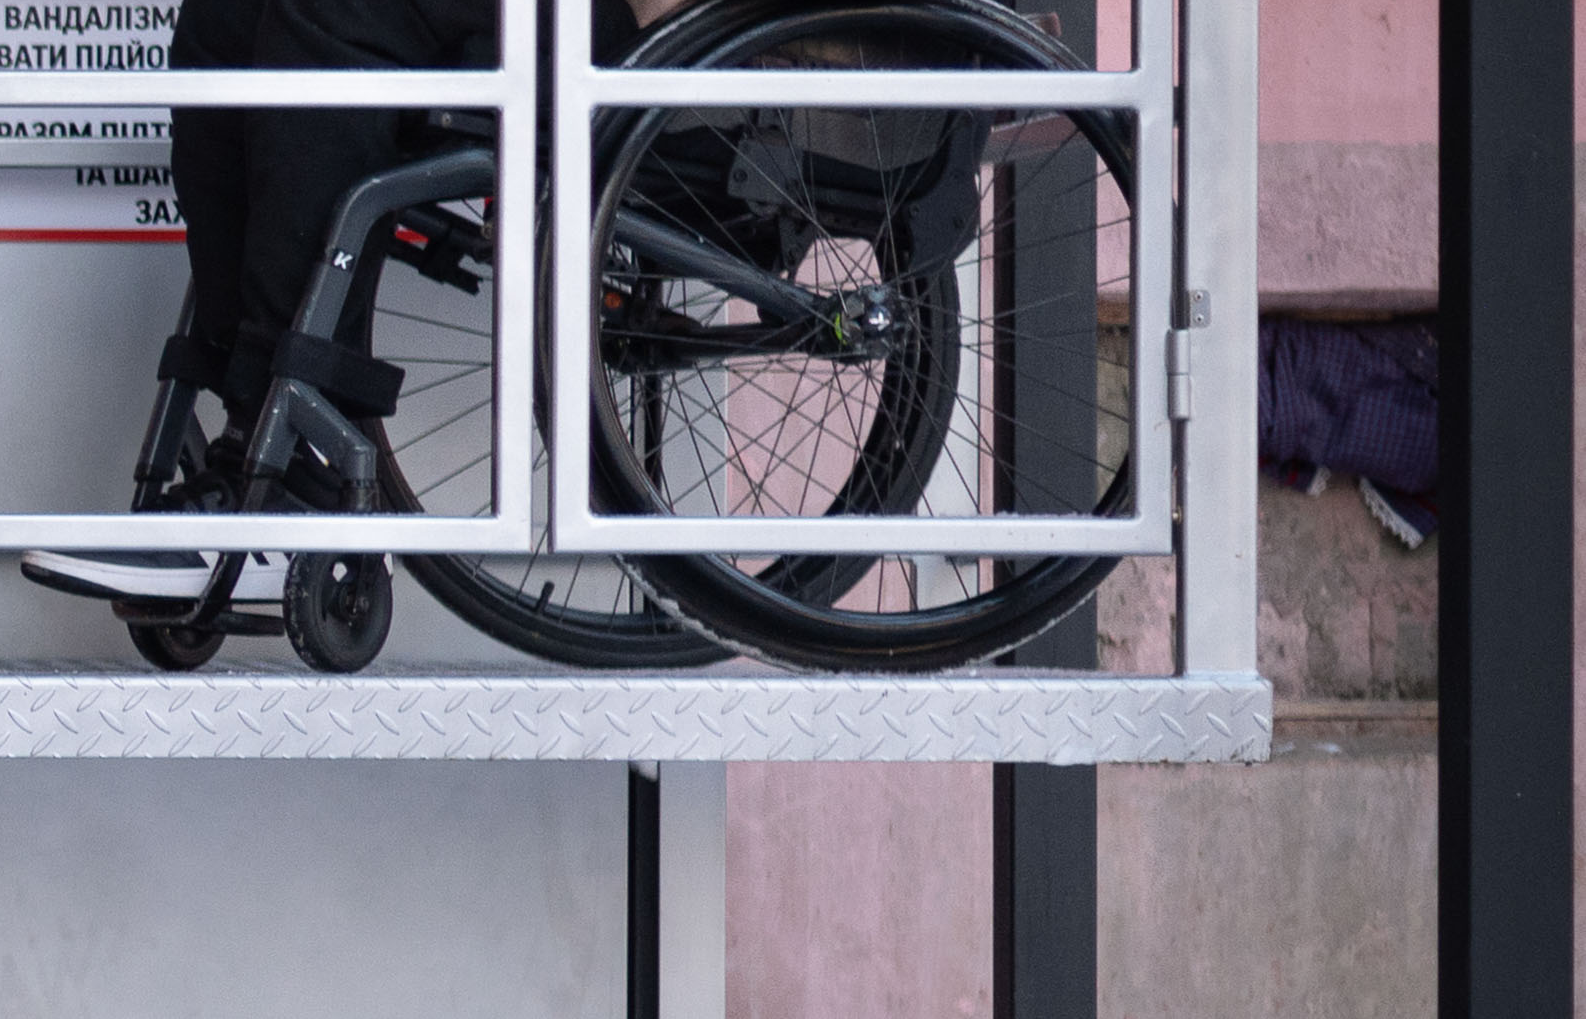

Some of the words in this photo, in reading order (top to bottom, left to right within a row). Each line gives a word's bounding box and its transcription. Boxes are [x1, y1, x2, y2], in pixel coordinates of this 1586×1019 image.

[5, 5, 182, 35] ВАНДАЛІЗМ
[76, 40, 172, 69] ПІДЙО
[101, 122, 173, 138] ПІДТ
